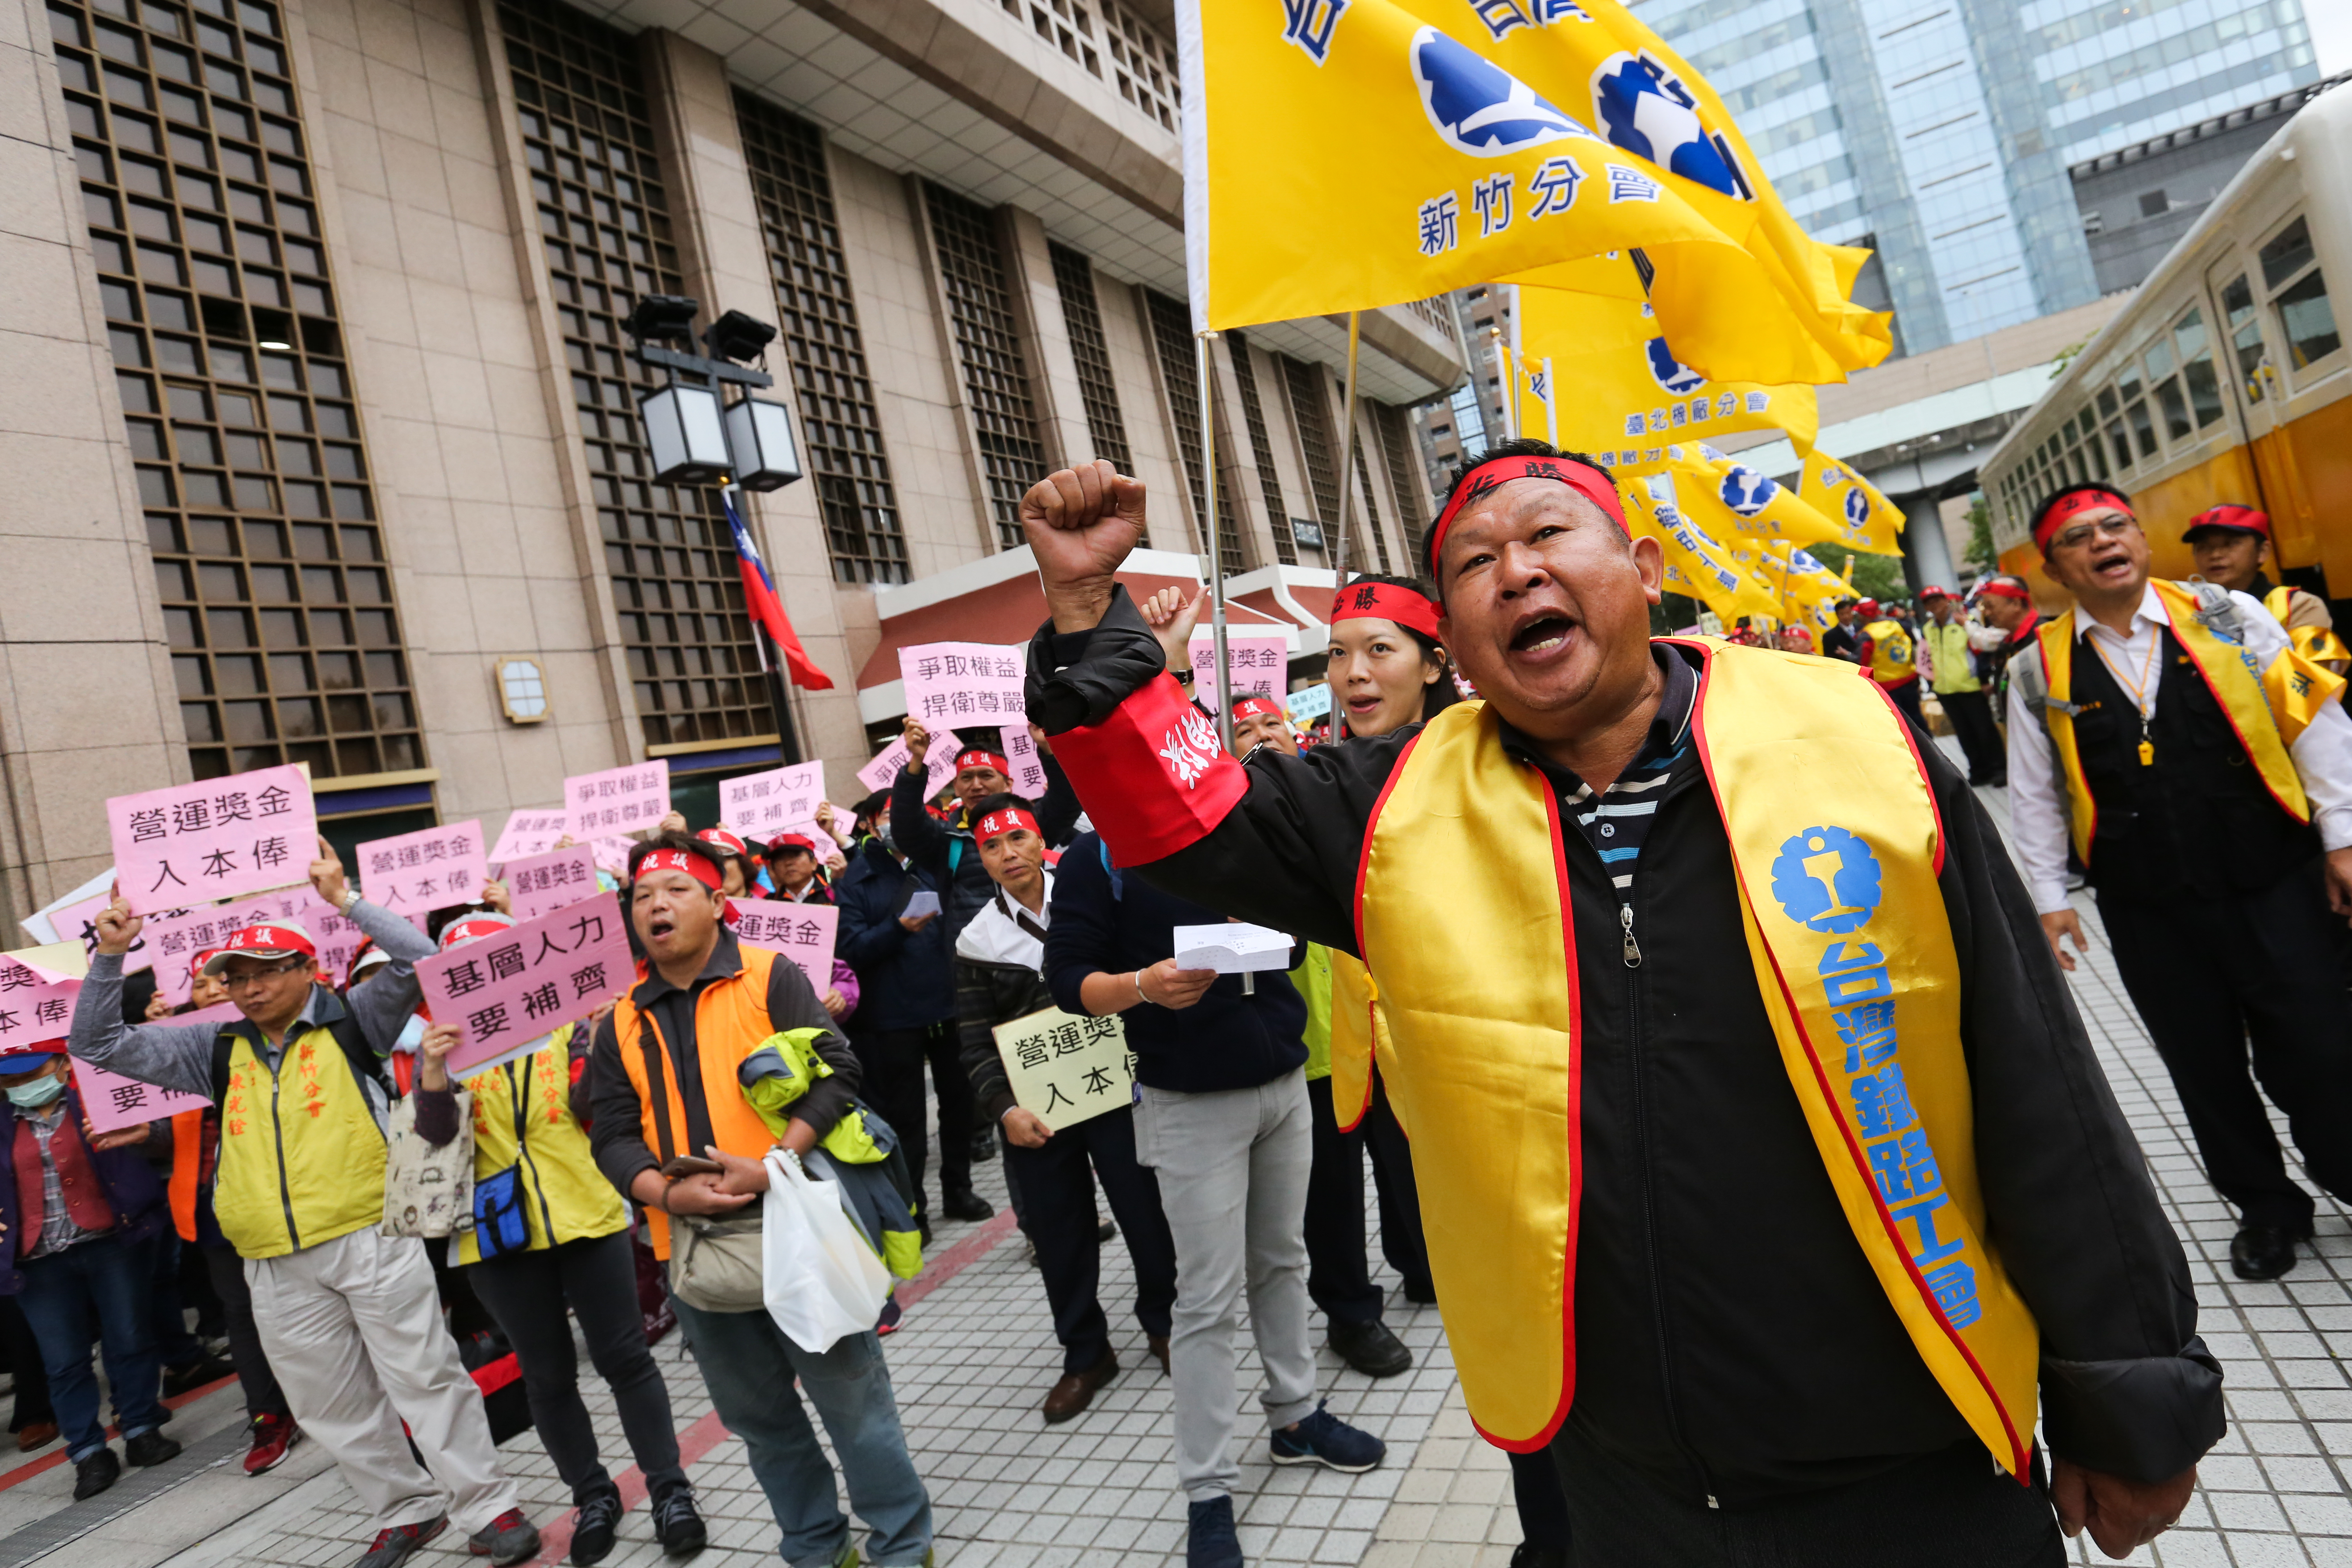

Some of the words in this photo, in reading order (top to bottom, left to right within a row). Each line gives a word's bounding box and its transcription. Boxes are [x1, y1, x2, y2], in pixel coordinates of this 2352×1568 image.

[1420, 159, 1659, 252] 新竹分會
[1627, 391, 1770, 435] 臺北機廠分會
[918, 655, 1018, 680] 爭取權益
[923, 691, 1025, 718] 捍衛尊嚴
[963, 753, 992, 765] 抗議
[1012, 734, 1036, 756] 基
[578, 771, 659, 803] 爭取權益
[731, 772, 812, 803] 基層人力
[130, 786, 292, 843] 營運獎金
[580, 799, 661, 831] 捍衛尊嚴
[737, 797, 809, 826] 要補齊
[984, 811, 1022, 834] 抗議
[151, 836, 288, 893] 入本俸
[371, 834, 473, 874] 營運獎金
[641, 853, 689, 872] 抗議
[383, 870, 470, 907] 入本俸
[516, 860, 587, 894] 營運獎金
[230, 928, 274, 949] 抗議
[737, 915, 822, 946] 運獎金
[442, 915, 605, 999] 基層人力
[0, 964, 47, 992] 獎
[467, 961, 607, 1044] 要補齊
[1015, 1015, 1125, 1070] 營運獎
[1818, 941, 1982, 1332] 台灣鐵路工會
